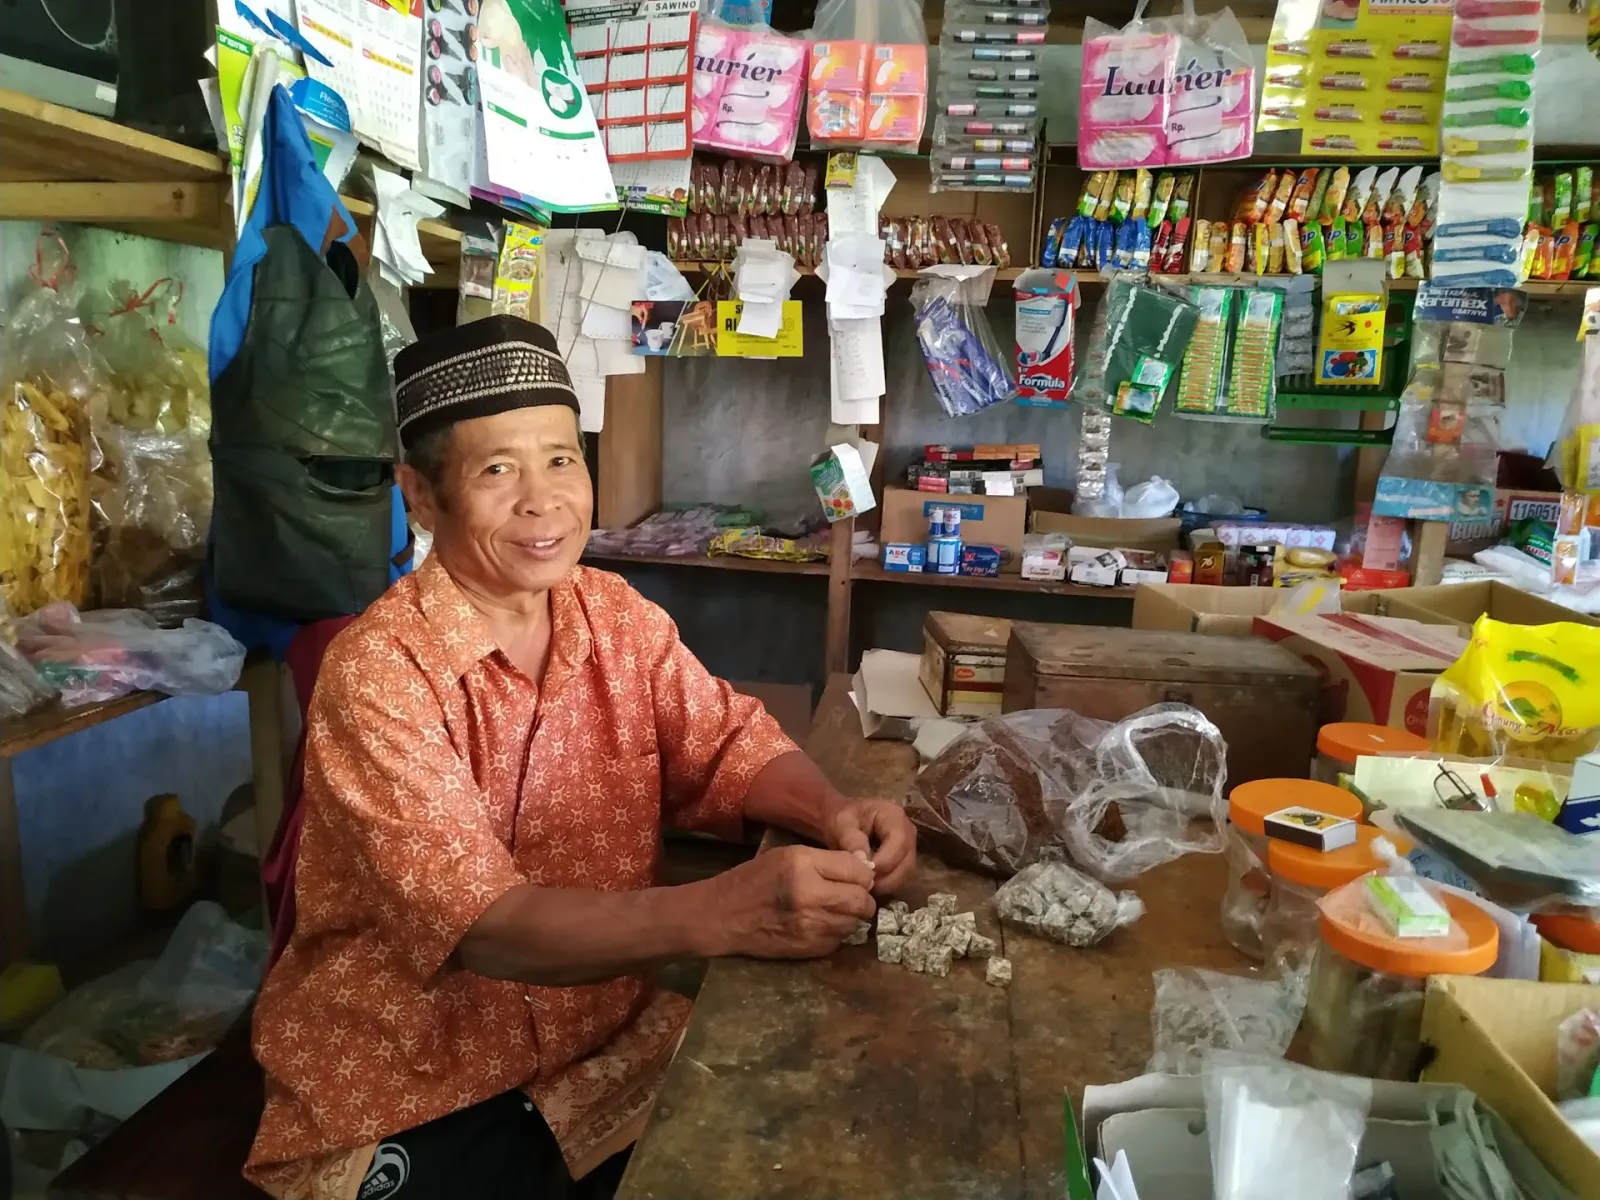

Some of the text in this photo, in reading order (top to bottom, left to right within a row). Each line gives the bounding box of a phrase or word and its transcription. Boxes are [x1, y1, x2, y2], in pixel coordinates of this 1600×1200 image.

[655, 1, 696, 10] SAWINO
[692, 52, 782, 83] aurier
[1102, 59, 1231, 97] Laurier
[722, 103, 734, 114] Rp.
[1171, 122, 1185, 132] Rp.
[1452, 308, 1488, 317] OBATNYA
[1019, 374, 1065, 388] Formula
[888, 549, 906, 557] ABC
[1201, 556, 1213, 568] 76
[362, 1180, 395, 1198] adidas
